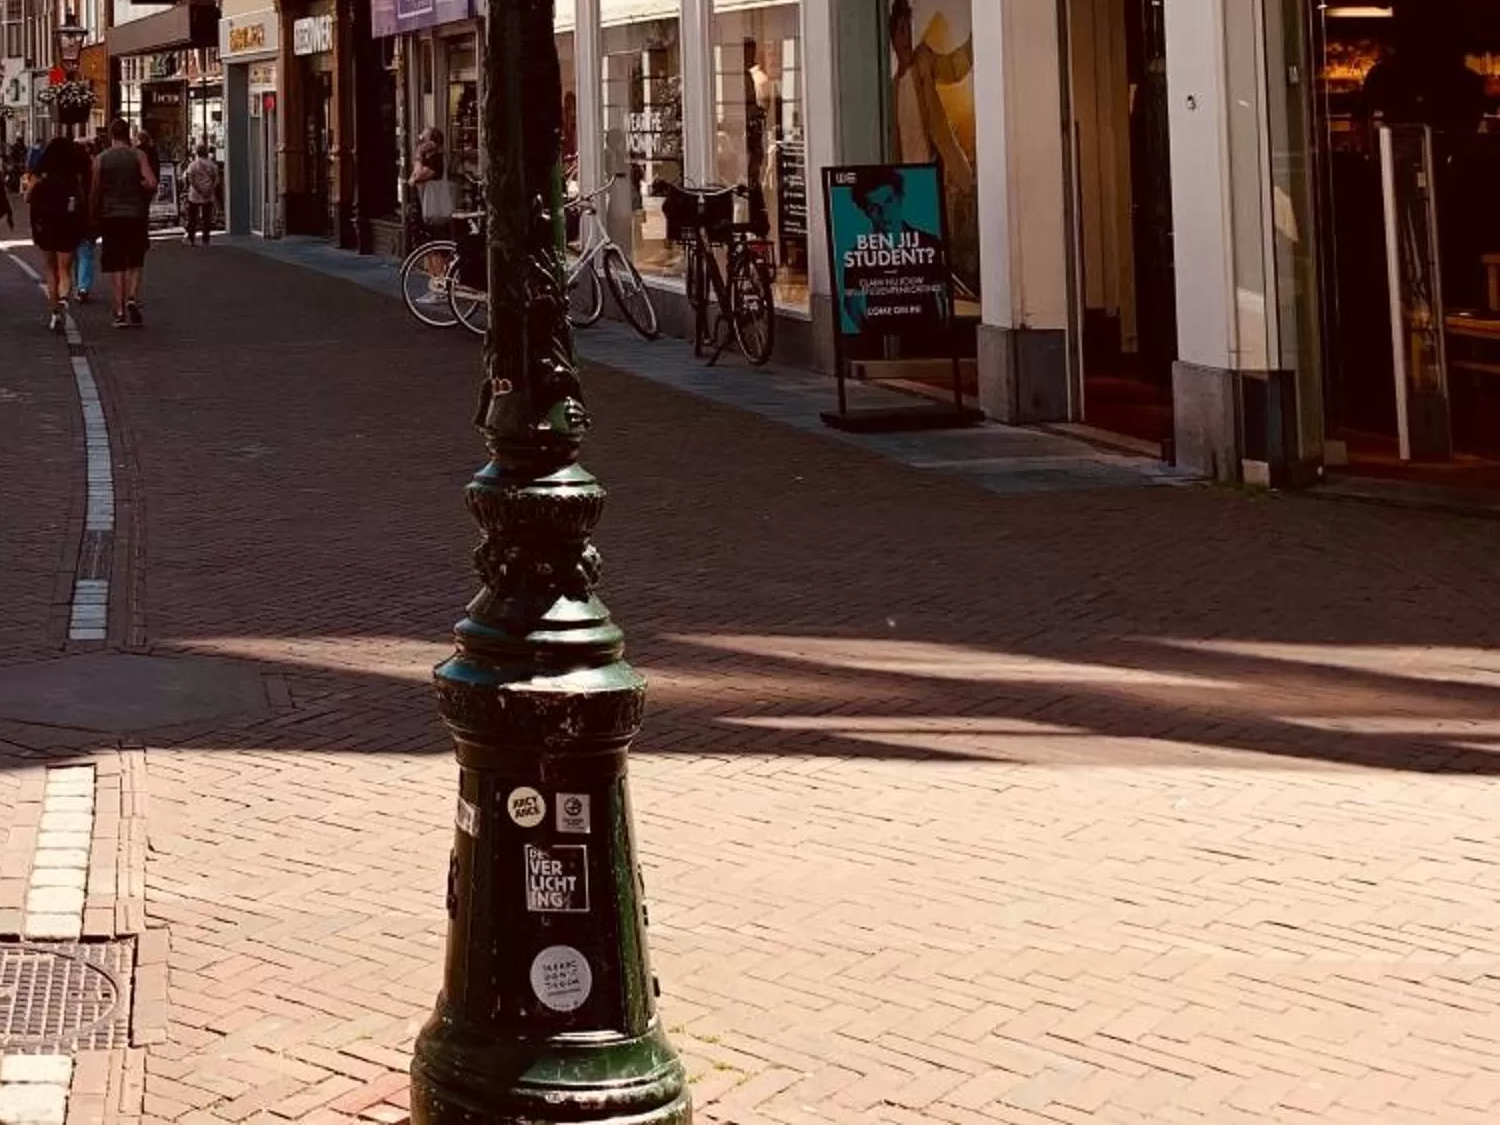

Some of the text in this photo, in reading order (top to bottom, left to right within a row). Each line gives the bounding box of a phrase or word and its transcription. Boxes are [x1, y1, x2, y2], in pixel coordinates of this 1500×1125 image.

[856, 231, 920, 250] BEN JIJ
[843, 247, 935, 268] STUDENT?
[530, 860, 562, 876] VER
[531, 876, 577, 892] LICHT
[532, 892, 563, 908] ING
